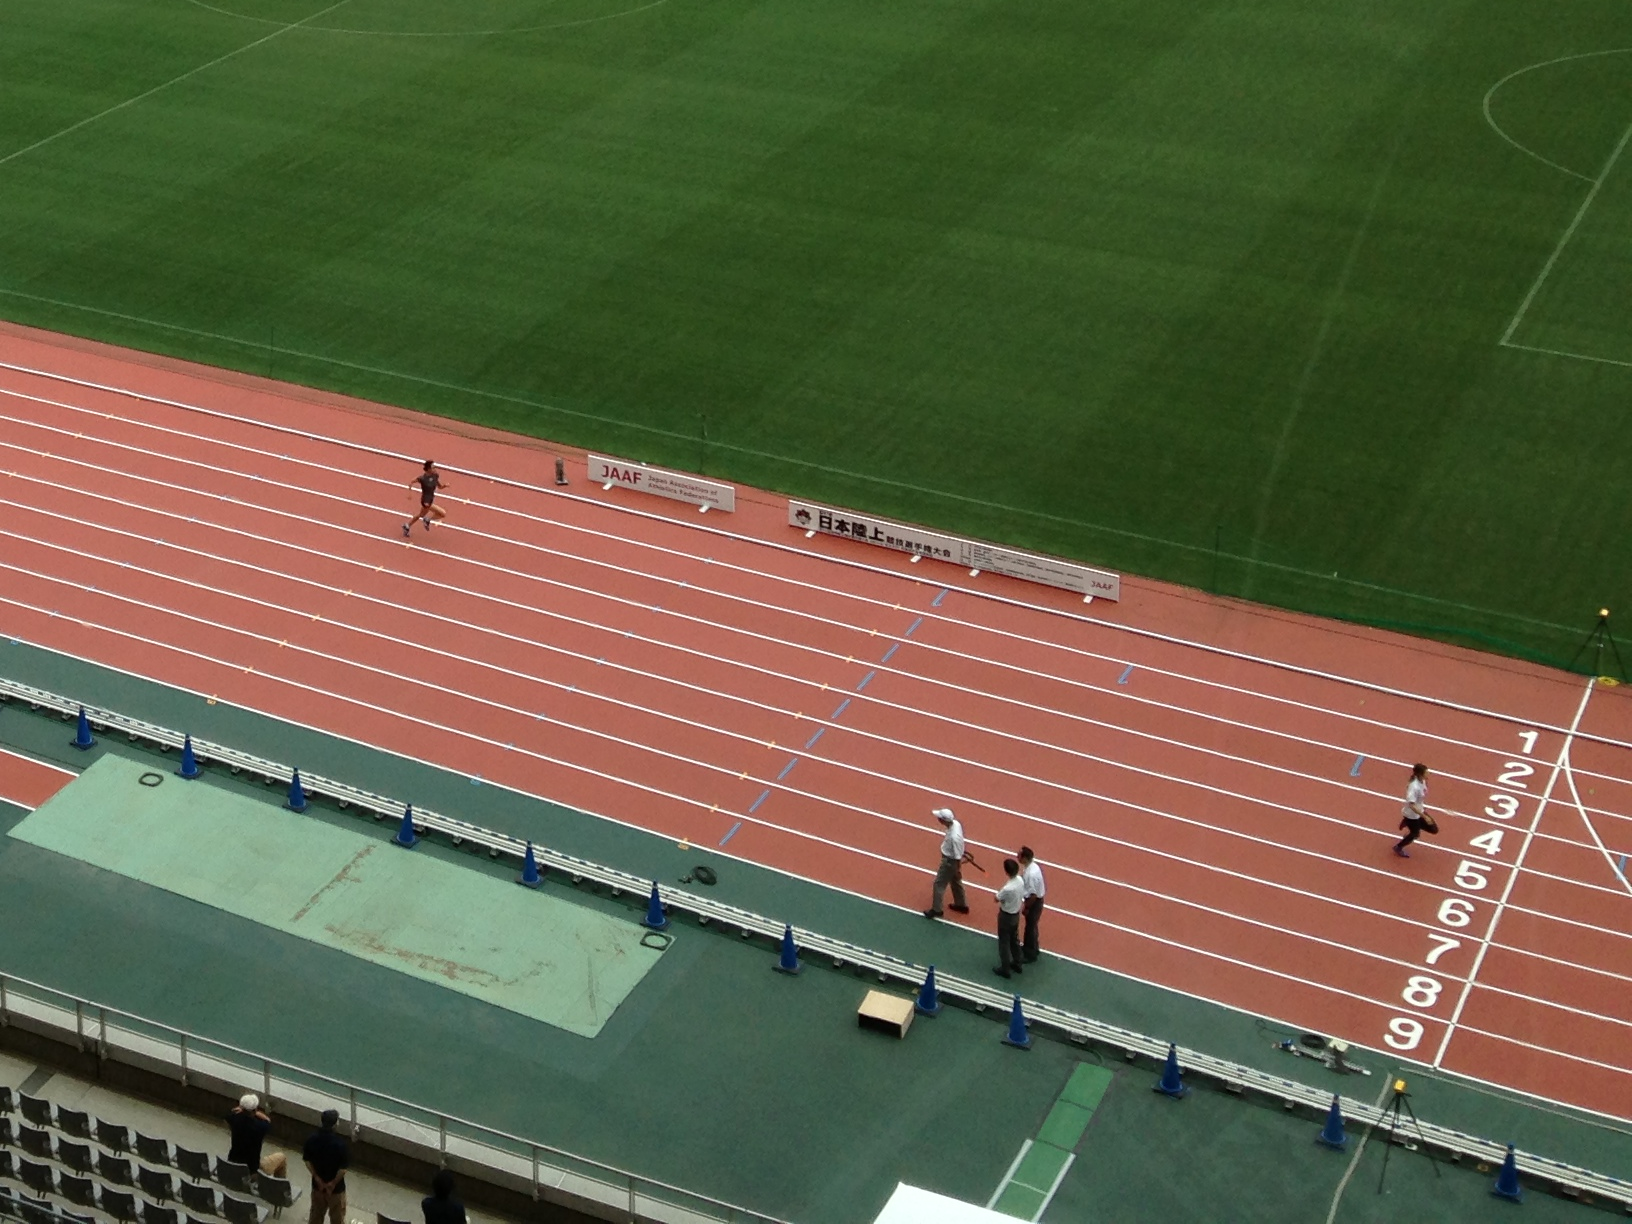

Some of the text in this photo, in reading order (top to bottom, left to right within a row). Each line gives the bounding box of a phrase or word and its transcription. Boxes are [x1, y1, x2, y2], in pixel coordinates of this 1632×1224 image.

[601, 465, 642, 485] JAAF
[648, 475, 667, 485] Japan
[669, 479, 709, 494] Association
[679, 490, 719, 504] Federations
[1091, 580, 1113, 591] JAAF
[1518, 731, 1538, 754] 1
[1497, 762, 1534, 788] 2
[1484, 794, 1520, 820] 3
[1469, 830, 1504, 855] 4
[1453, 860, 1492, 890] 5
[1437, 898, 1475, 928] 6
[1426, 933, 1461, 965] 7
[1402, 976, 1442, 1008] 8
[1383, 1017, 1424, 1050] 9
